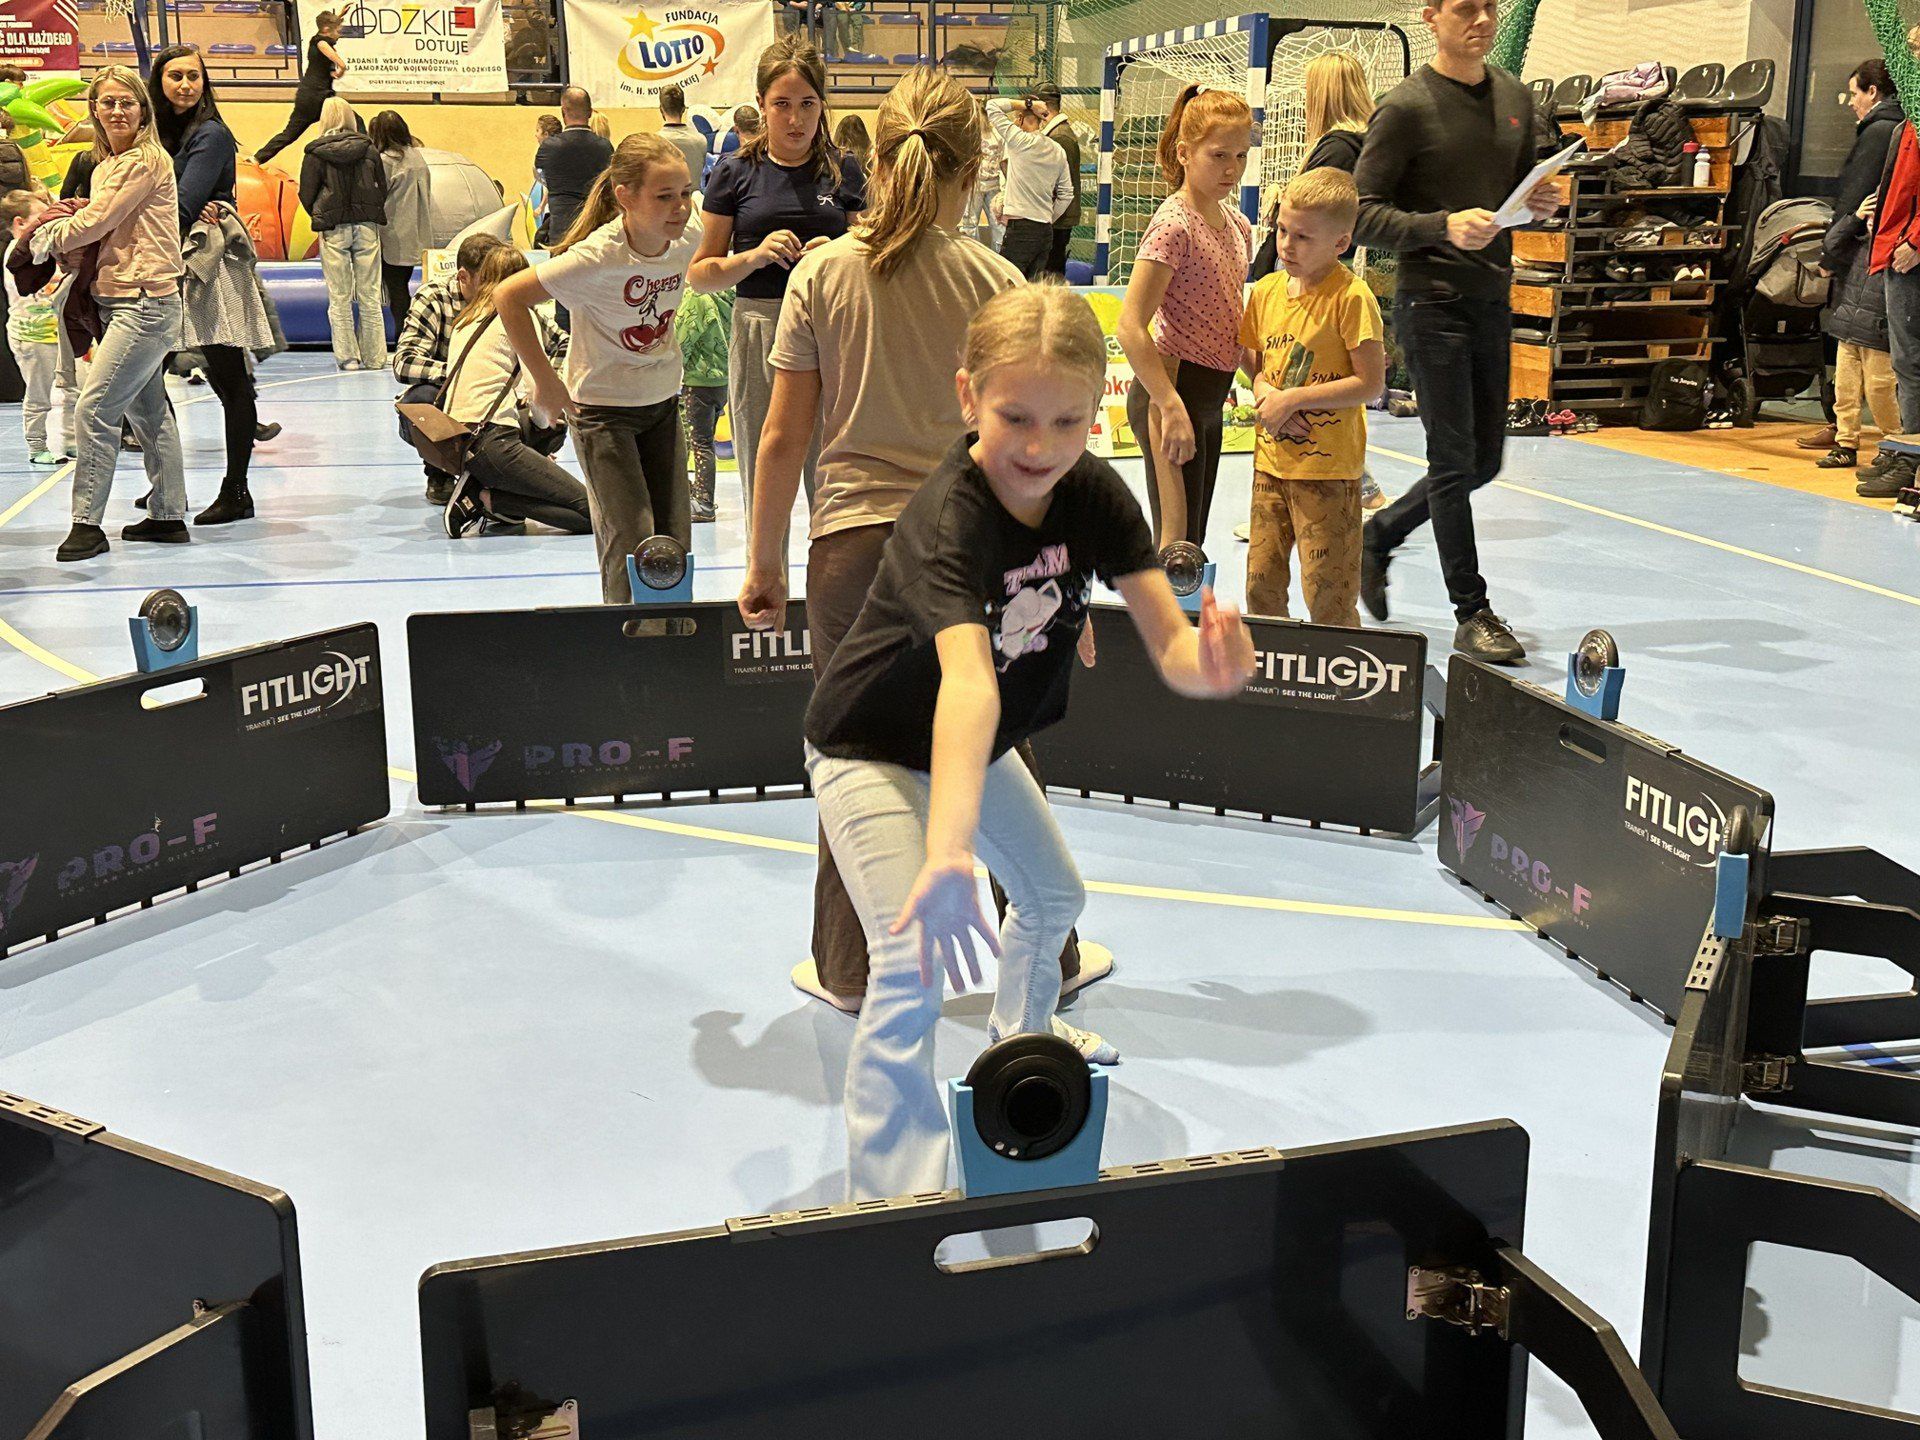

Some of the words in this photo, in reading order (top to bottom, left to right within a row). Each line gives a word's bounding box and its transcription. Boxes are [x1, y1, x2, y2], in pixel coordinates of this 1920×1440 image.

[331, 4, 468, 38] ÓDZKIE
[665, 9, 719, 25] FUNDACJA
[6, 32, 26, 46] DLA
[28, 30, 72, 46] KAŻDEGO
[415, 38, 469, 55] DOTUJE
[347, 57, 379, 65] ZADANIE
[638, 34, 705, 69] LOTTO
[648, 74, 700, 95] KOCKIEJ
[624, 272, 682, 307] Cherry
[732, 629, 811, 660] FITLI
[241, 651, 370, 716] FITLIGHT
[1282, 689, 1296, 697] SEE
[1298, 690, 1312, 699] THE
[1314, 692, 1337, 701] LIGHT
[1625, 775, 1728, 868] FITLIGH
